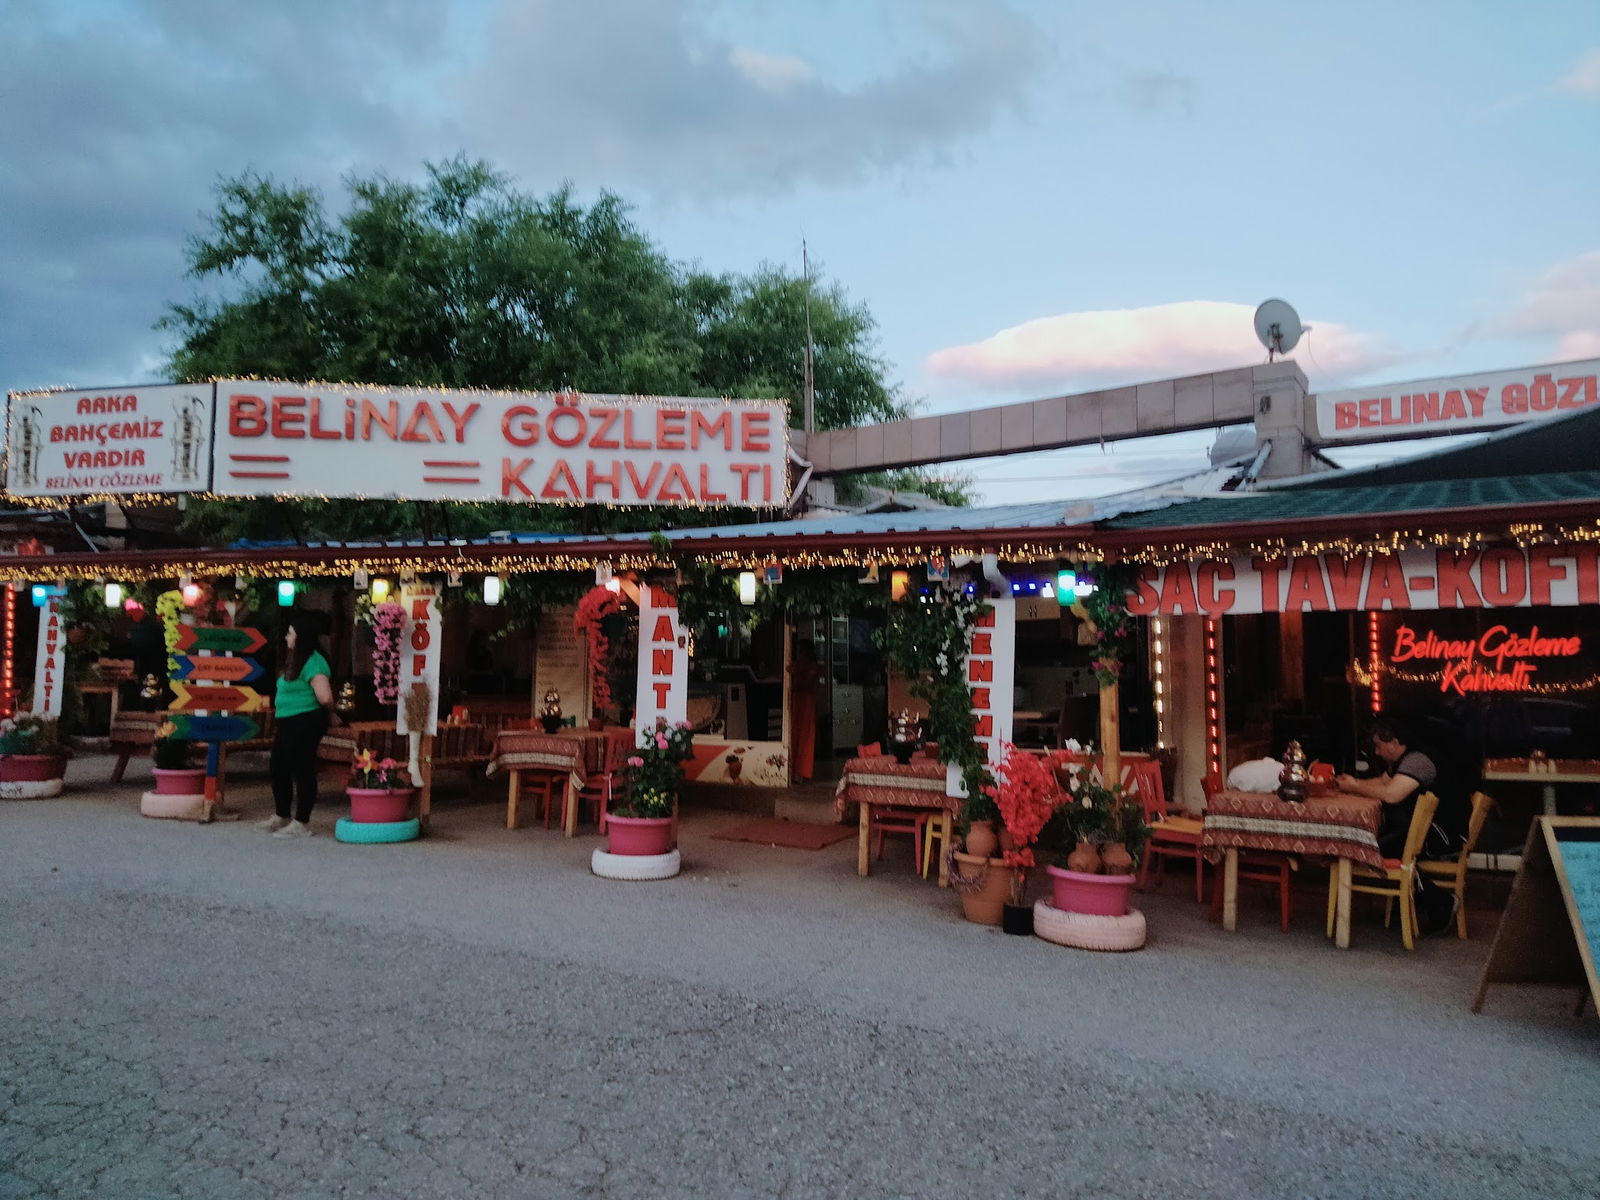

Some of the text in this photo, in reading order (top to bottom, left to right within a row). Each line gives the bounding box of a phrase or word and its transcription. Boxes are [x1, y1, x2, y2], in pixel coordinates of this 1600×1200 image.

[76, 394, 138, 416] ARKA
[501, 394, 771, 452] GÖZLEME
[49, 416, 164, 446] BAHÇEMİZ
[63, 448, 146, 470] VARDIR
[99, 470, 163, 488] GÖZLEME
[501, 457, 772, 502] KAHVALTI
[1125, 556, 1236, 621] SAÇ
[1391, 624, 1581, 671] Belinay Gözleme
